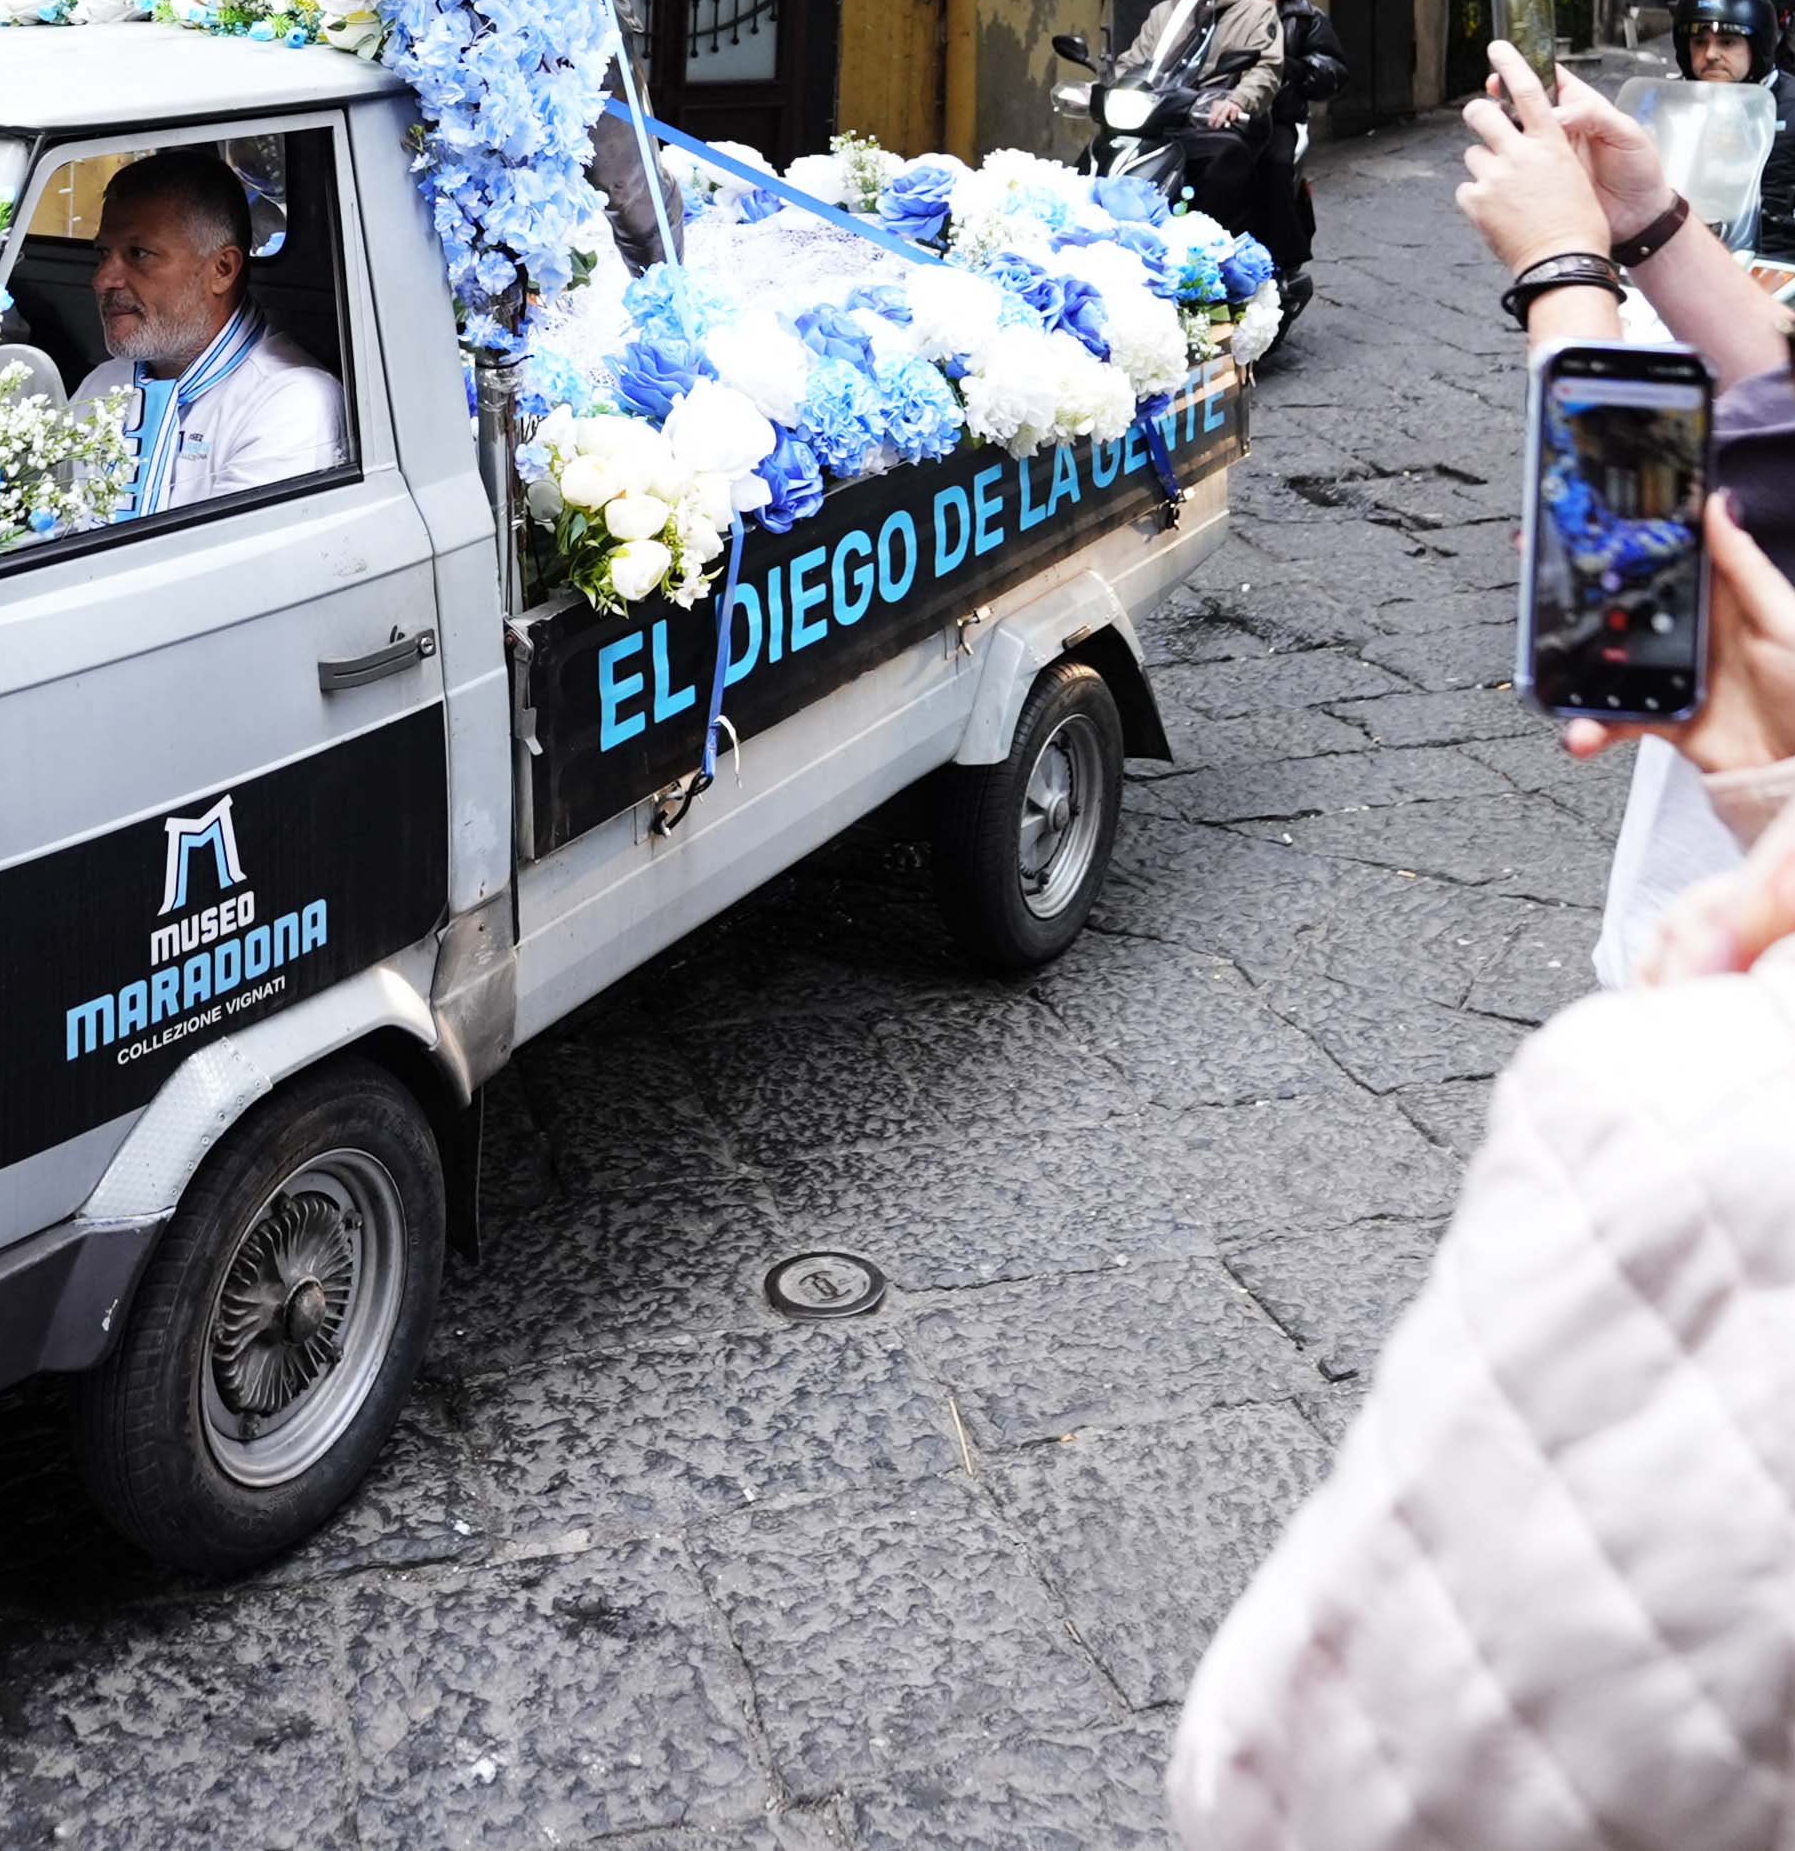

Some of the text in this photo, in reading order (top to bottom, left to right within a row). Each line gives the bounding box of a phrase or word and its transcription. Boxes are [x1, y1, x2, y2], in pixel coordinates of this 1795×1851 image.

[598, 620, 696, 752] EL
[715, 510, 917, 689] DIEGO
[934, 461, 1006, 580] DE
[1018, 442, 1082, 532] LA
[66, 898, 328, 1063] MARADONA
[150, 891, 255, 966] MUSEO
[117, 974, 286, 1066] COLLEZIONE VIGNATI
